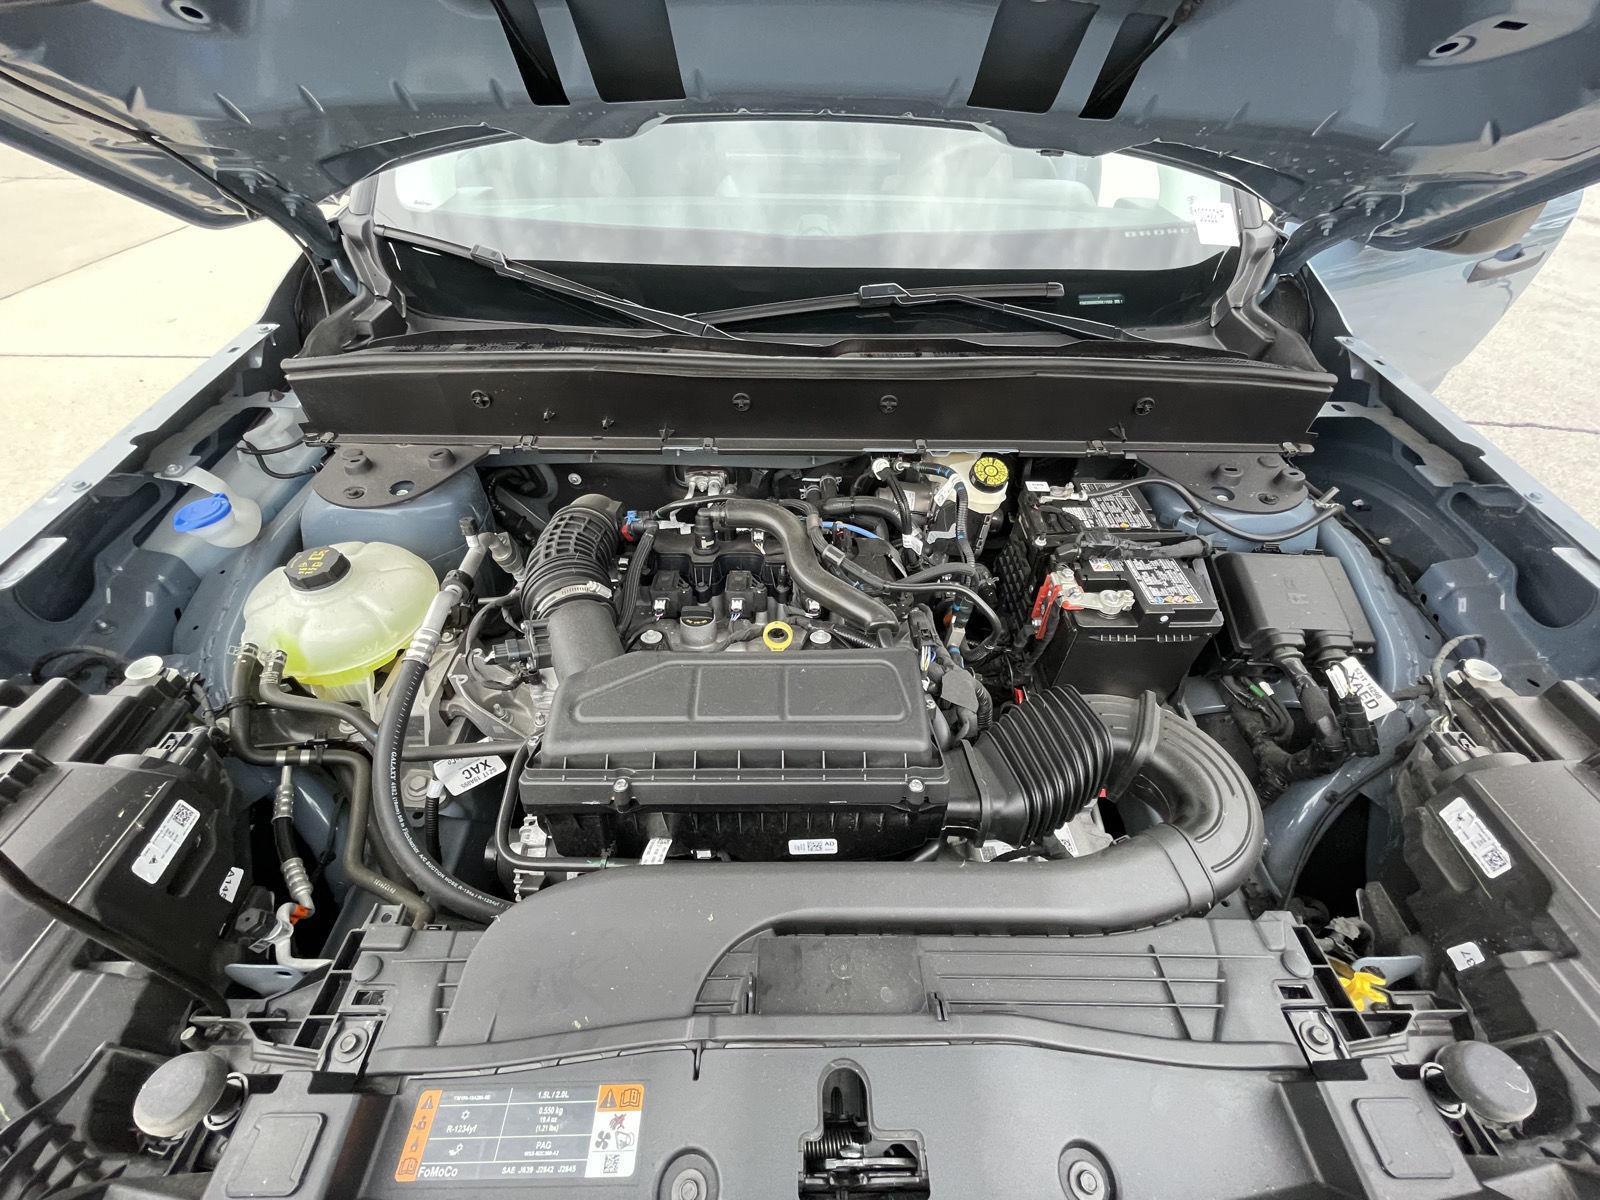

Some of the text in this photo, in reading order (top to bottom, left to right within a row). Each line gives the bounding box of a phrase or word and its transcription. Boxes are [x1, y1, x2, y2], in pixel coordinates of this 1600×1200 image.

[1349, 672, 1379, 710] XAED
[462, 760, 492, 780] XAC
[390, 752, 398, 781] GALAXY
[425, 860, 445, 880] SUCTION
[444, 876, 460, 889] HOSE
[538, 1106, 564, 1116] 0.550 kg
[446, 1124, 478, 1135] R-1234yf
[535, 1141, 552, 1150] PAG
[417, 1166, 458, 1178] FoMoCo
[501, 1166, 516, 1175] SAE
